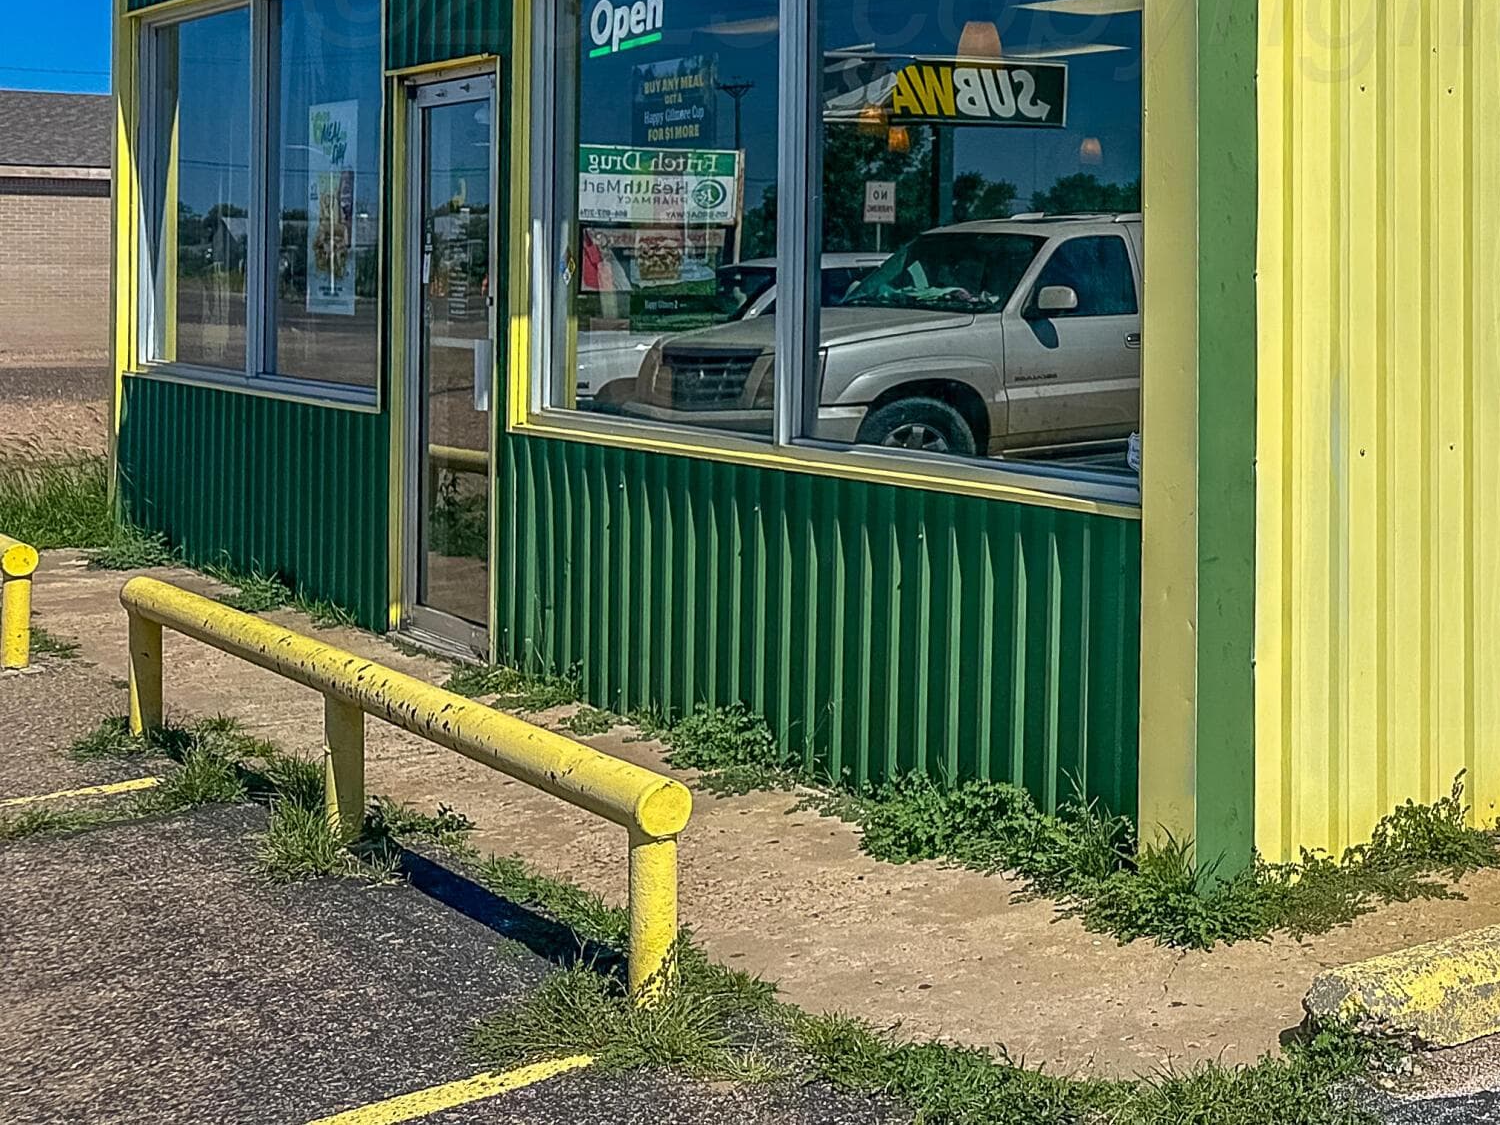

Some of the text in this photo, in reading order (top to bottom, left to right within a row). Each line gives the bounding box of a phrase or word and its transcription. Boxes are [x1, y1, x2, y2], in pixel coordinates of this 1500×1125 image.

[644, 74, 705, 95] BUY ANY MEAL
[677, 92, 683, 103] A
[643, 110, 664, 127] Happy
[691, 104, 705, 121] Cup
[647, 123, 700, 142] FOR $1 MORE
